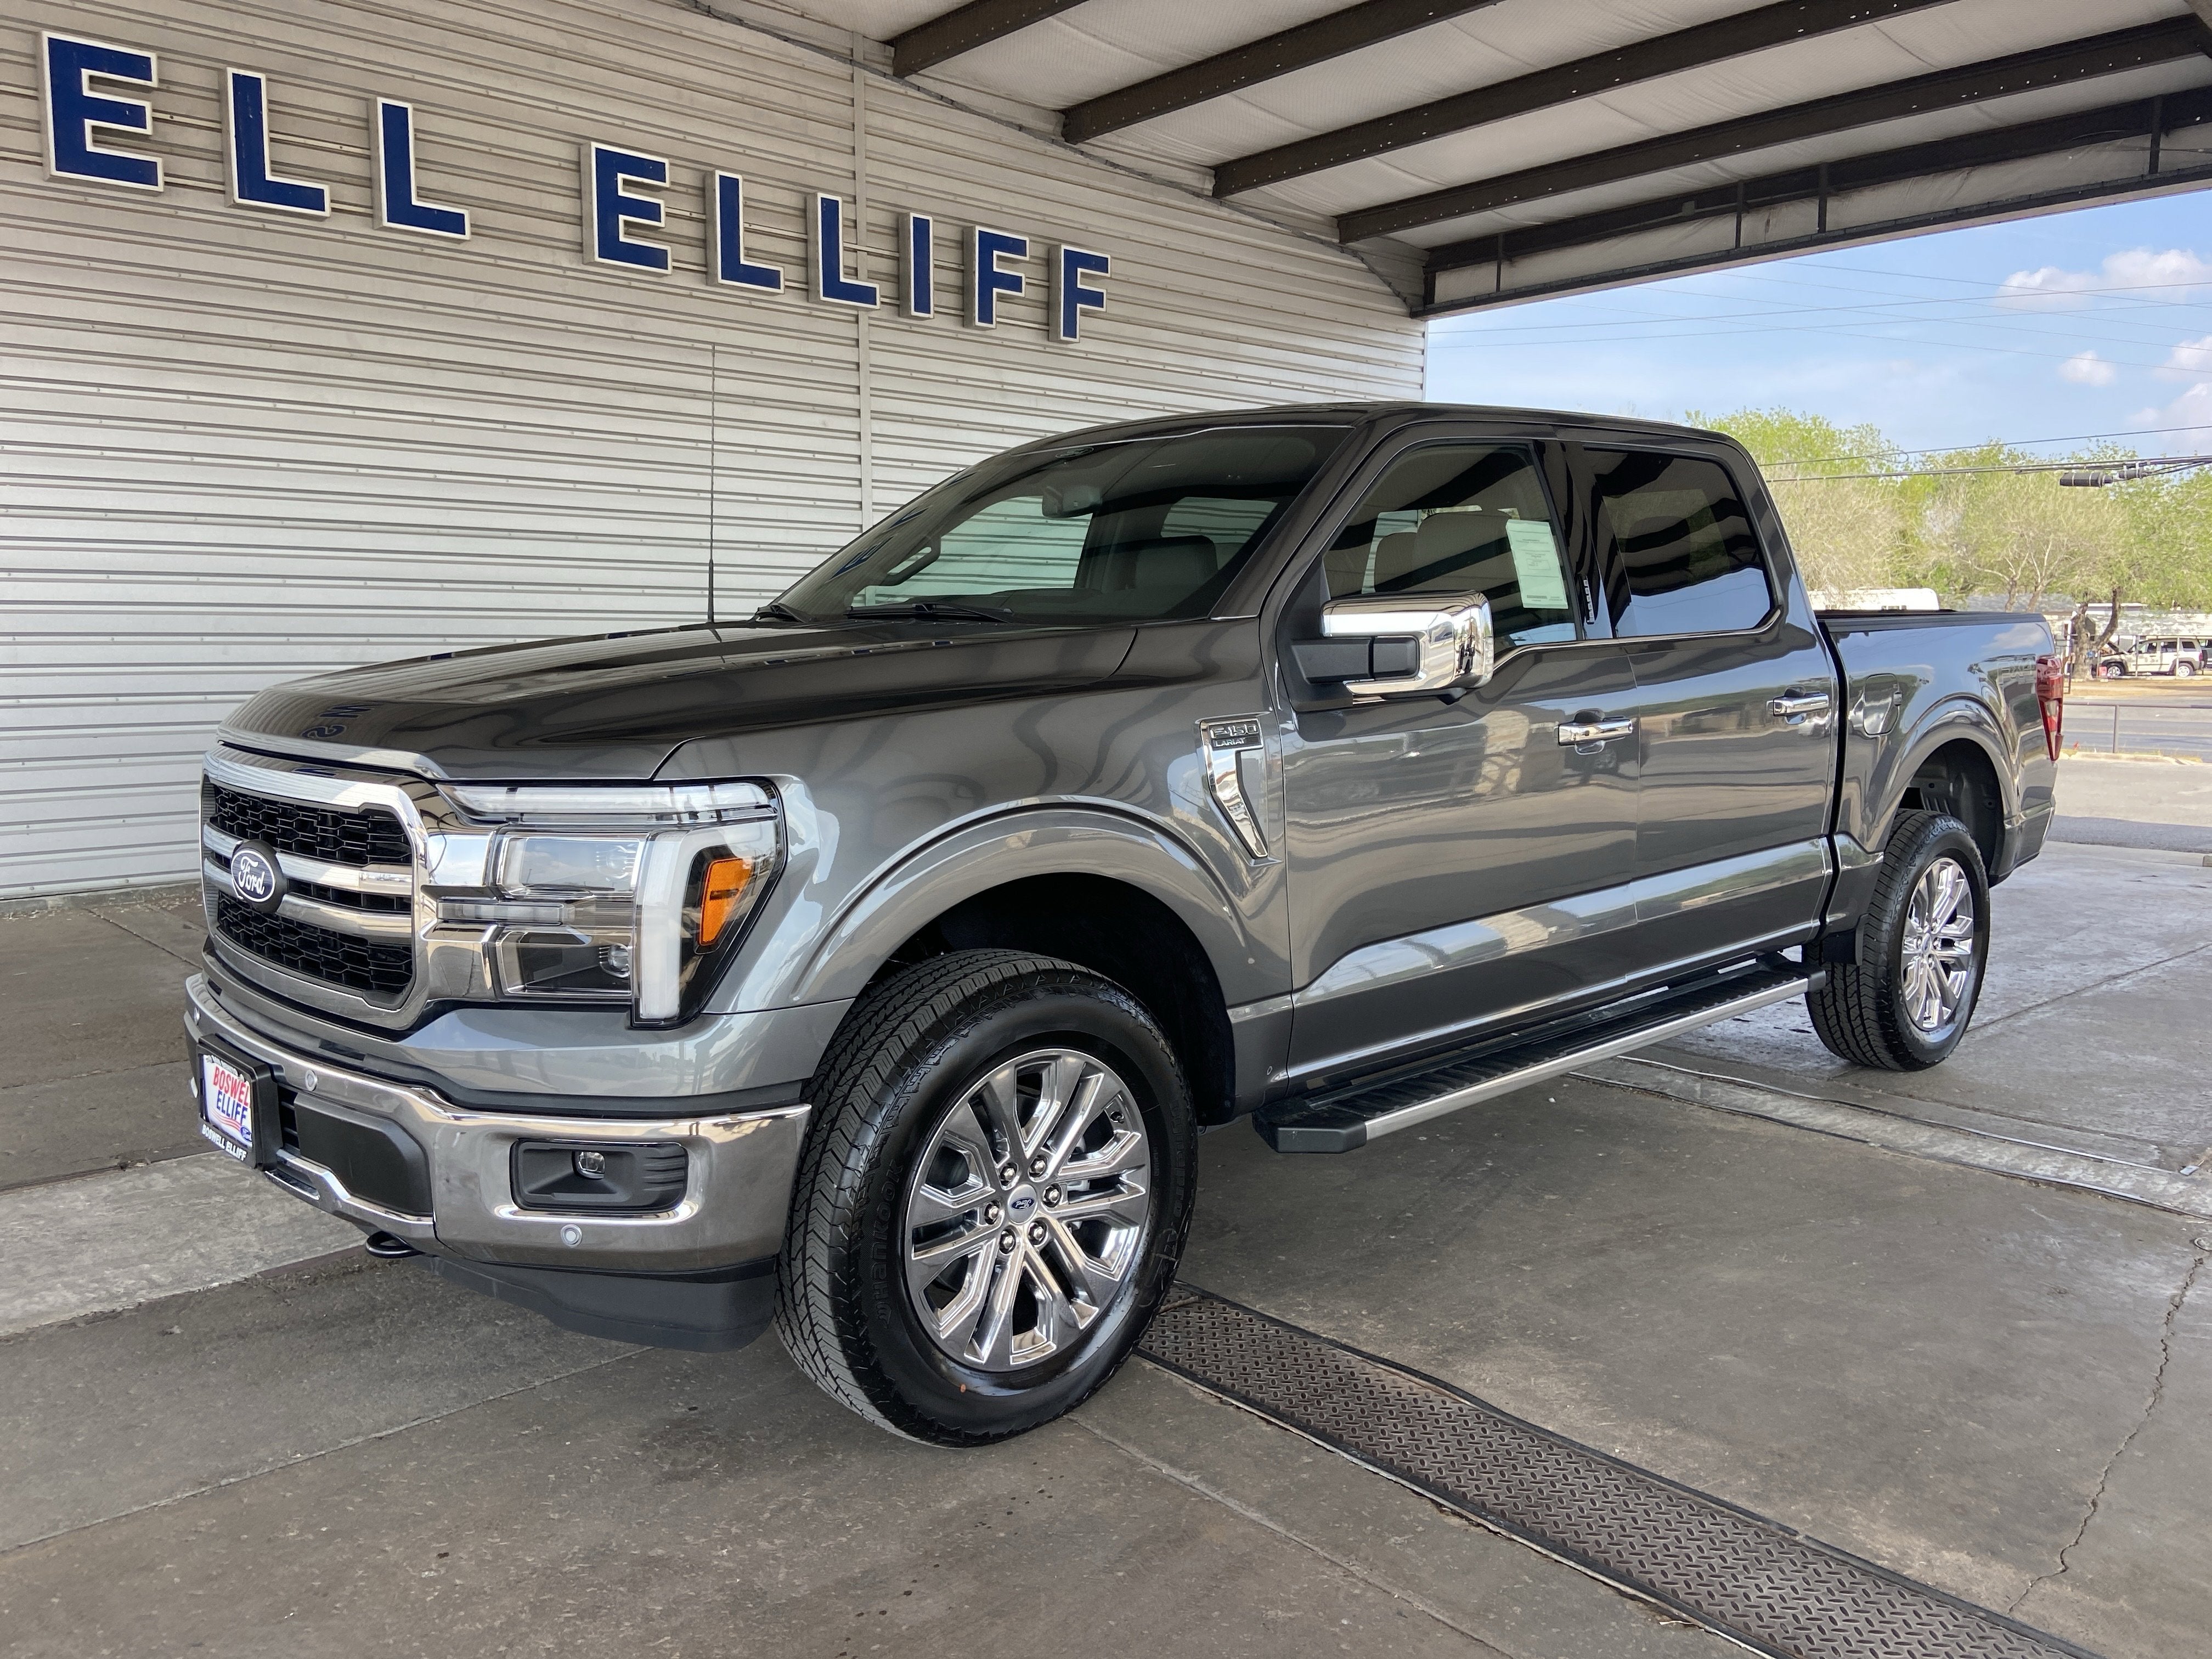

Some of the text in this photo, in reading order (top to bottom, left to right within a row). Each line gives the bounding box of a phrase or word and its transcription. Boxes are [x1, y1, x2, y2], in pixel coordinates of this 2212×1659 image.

[580, 141, 1111, 344] ELLIFF
[1210, 724, 1259, 738] F-150
[1215, 738, 1245, 747] LARIAT
[238, 856, 266, 895] Ford
[216, 1090, 247, 1125] ELLIFF
[202, 1124, 247, 1161] BOSWELL ELLIFF
